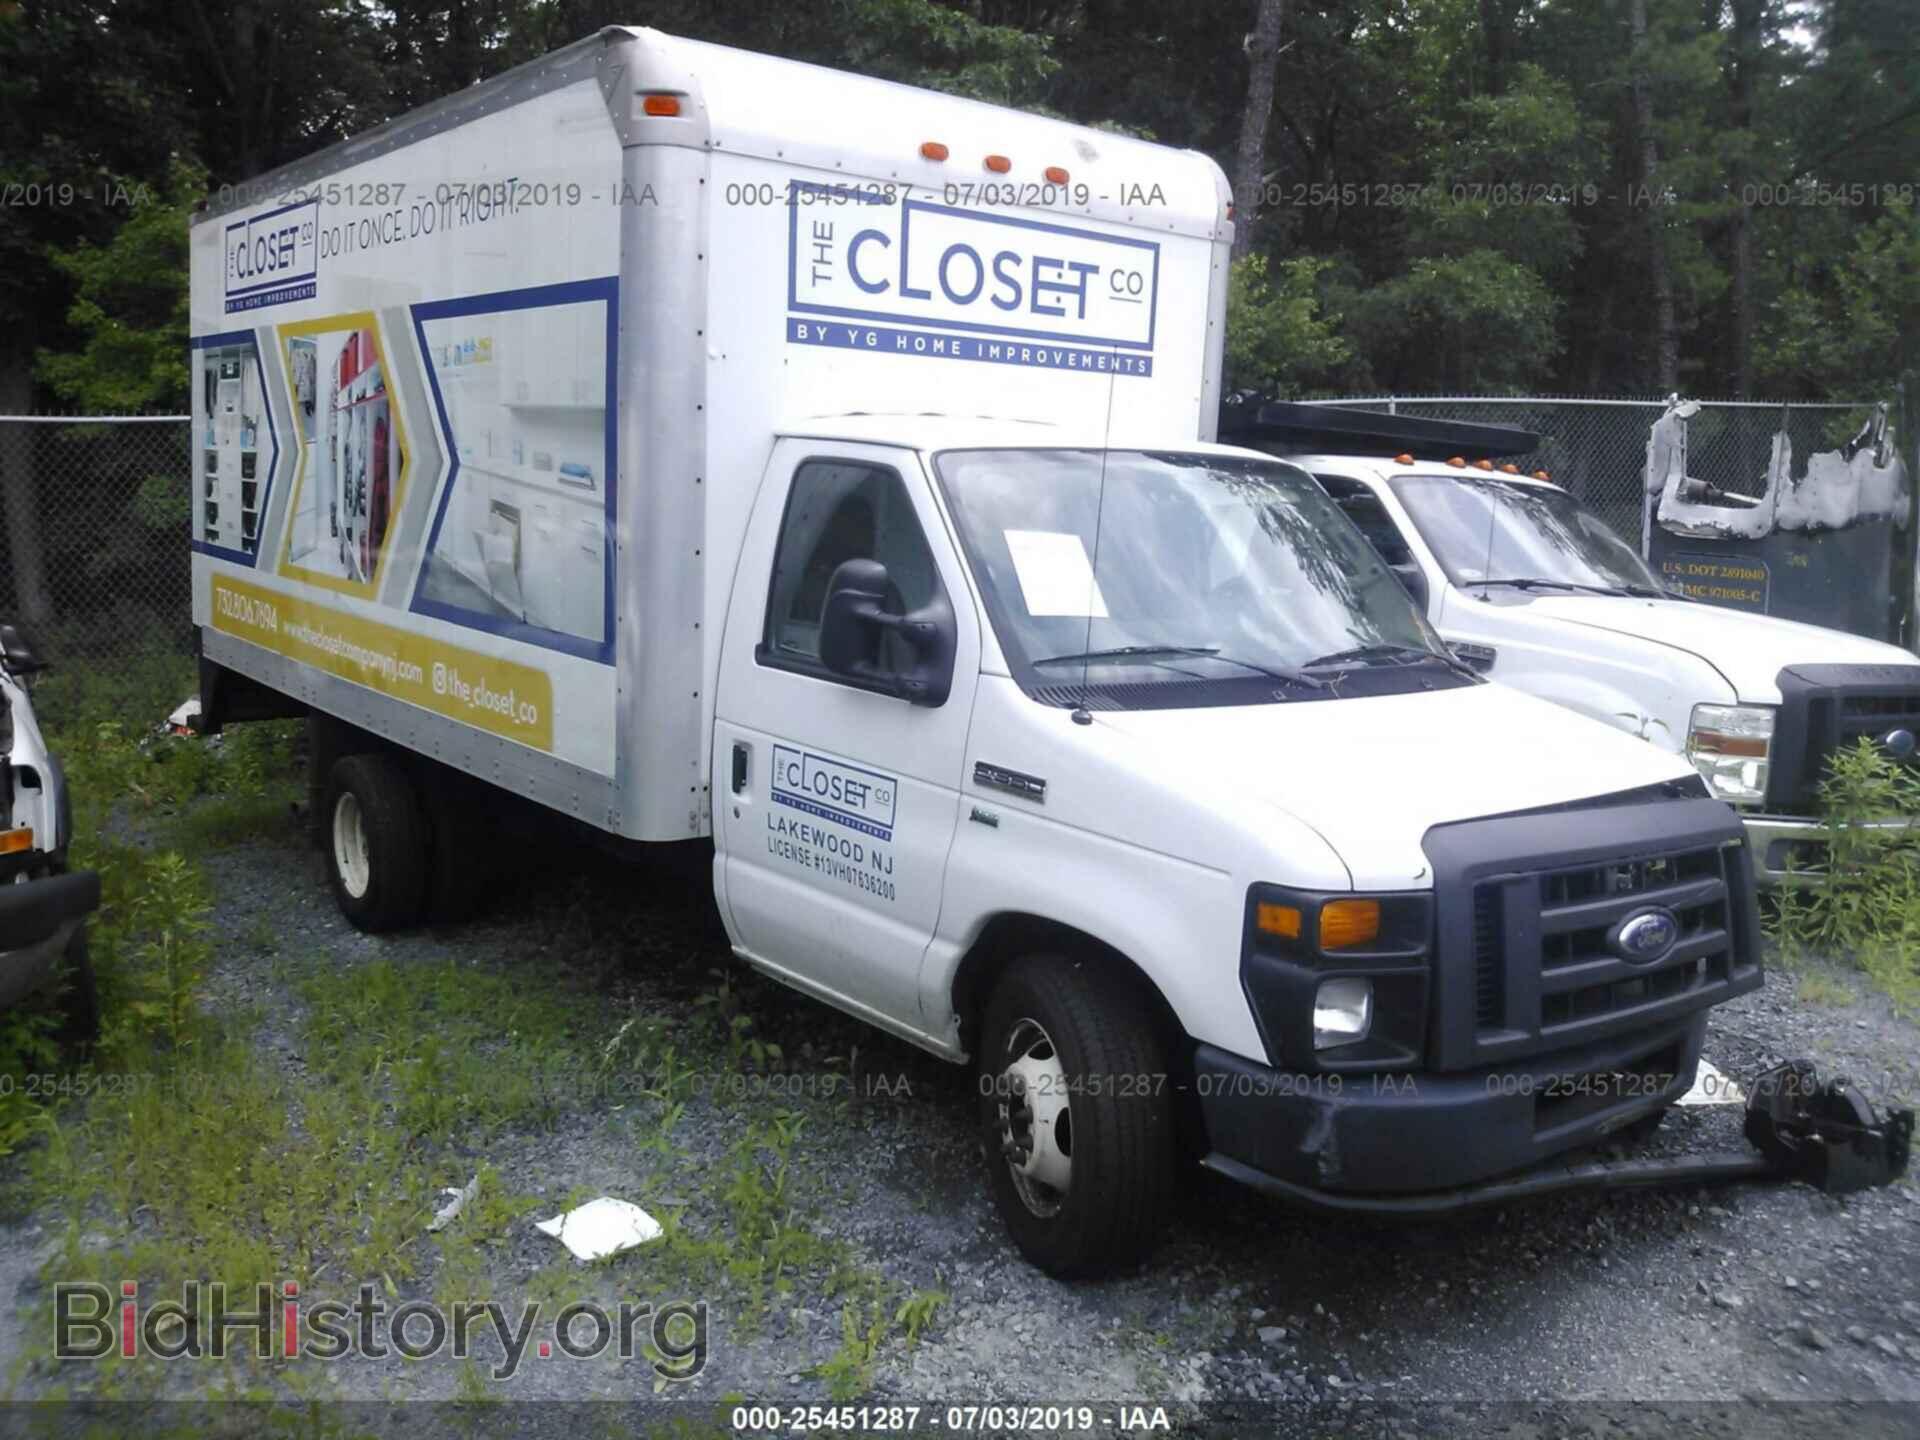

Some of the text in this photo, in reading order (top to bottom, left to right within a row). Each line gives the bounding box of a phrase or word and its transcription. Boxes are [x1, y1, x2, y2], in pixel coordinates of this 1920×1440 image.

[321, 177, 519, 259] DO IT ONCE. DO IT RIGHT.
[237, 226, 299, 279] CLOSET
[812, 220, 1143, 320] THE CLOSET CO
[797, 324, 1147, 373] BY YG HOME IMPROVEMENTS
[1663, 562, 1686, 575] U.S.
[1688, 563, 1717, 577] DOT
[787, 760, 871, 809] CLOSET
[875, 788, 890, 803] CO
[767, 836, 811, 868] LICENSE
[768, 812, 893, 875] LAKEWOOD NJ
